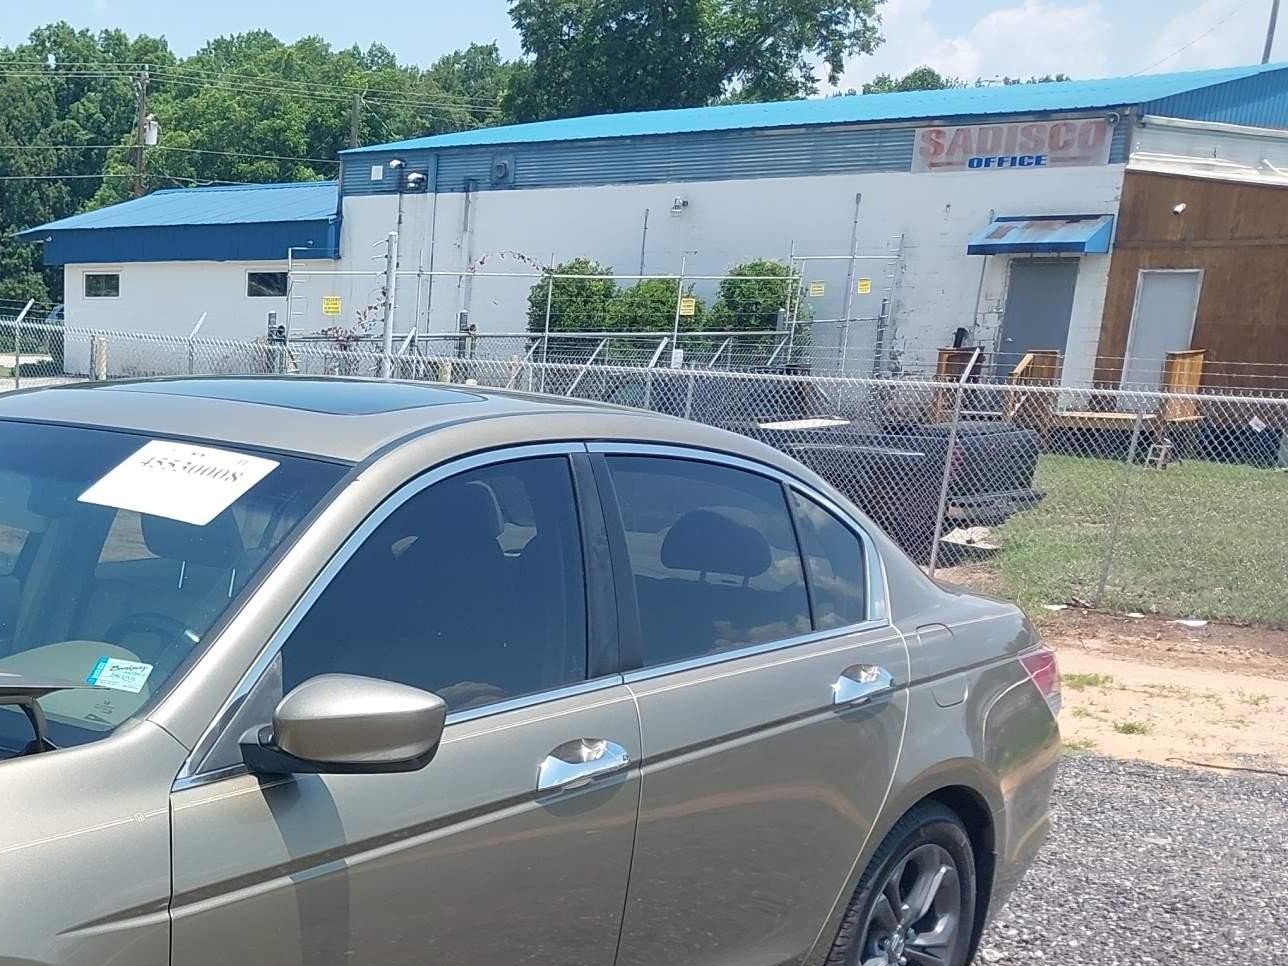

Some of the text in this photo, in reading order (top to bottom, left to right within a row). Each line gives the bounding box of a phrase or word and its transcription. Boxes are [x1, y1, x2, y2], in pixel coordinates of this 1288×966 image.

[918, 121, 1107, 157] SADISCO
[968, 154, 1049, 169] OFFICE
[140, 456, 244, 483] 45530008
